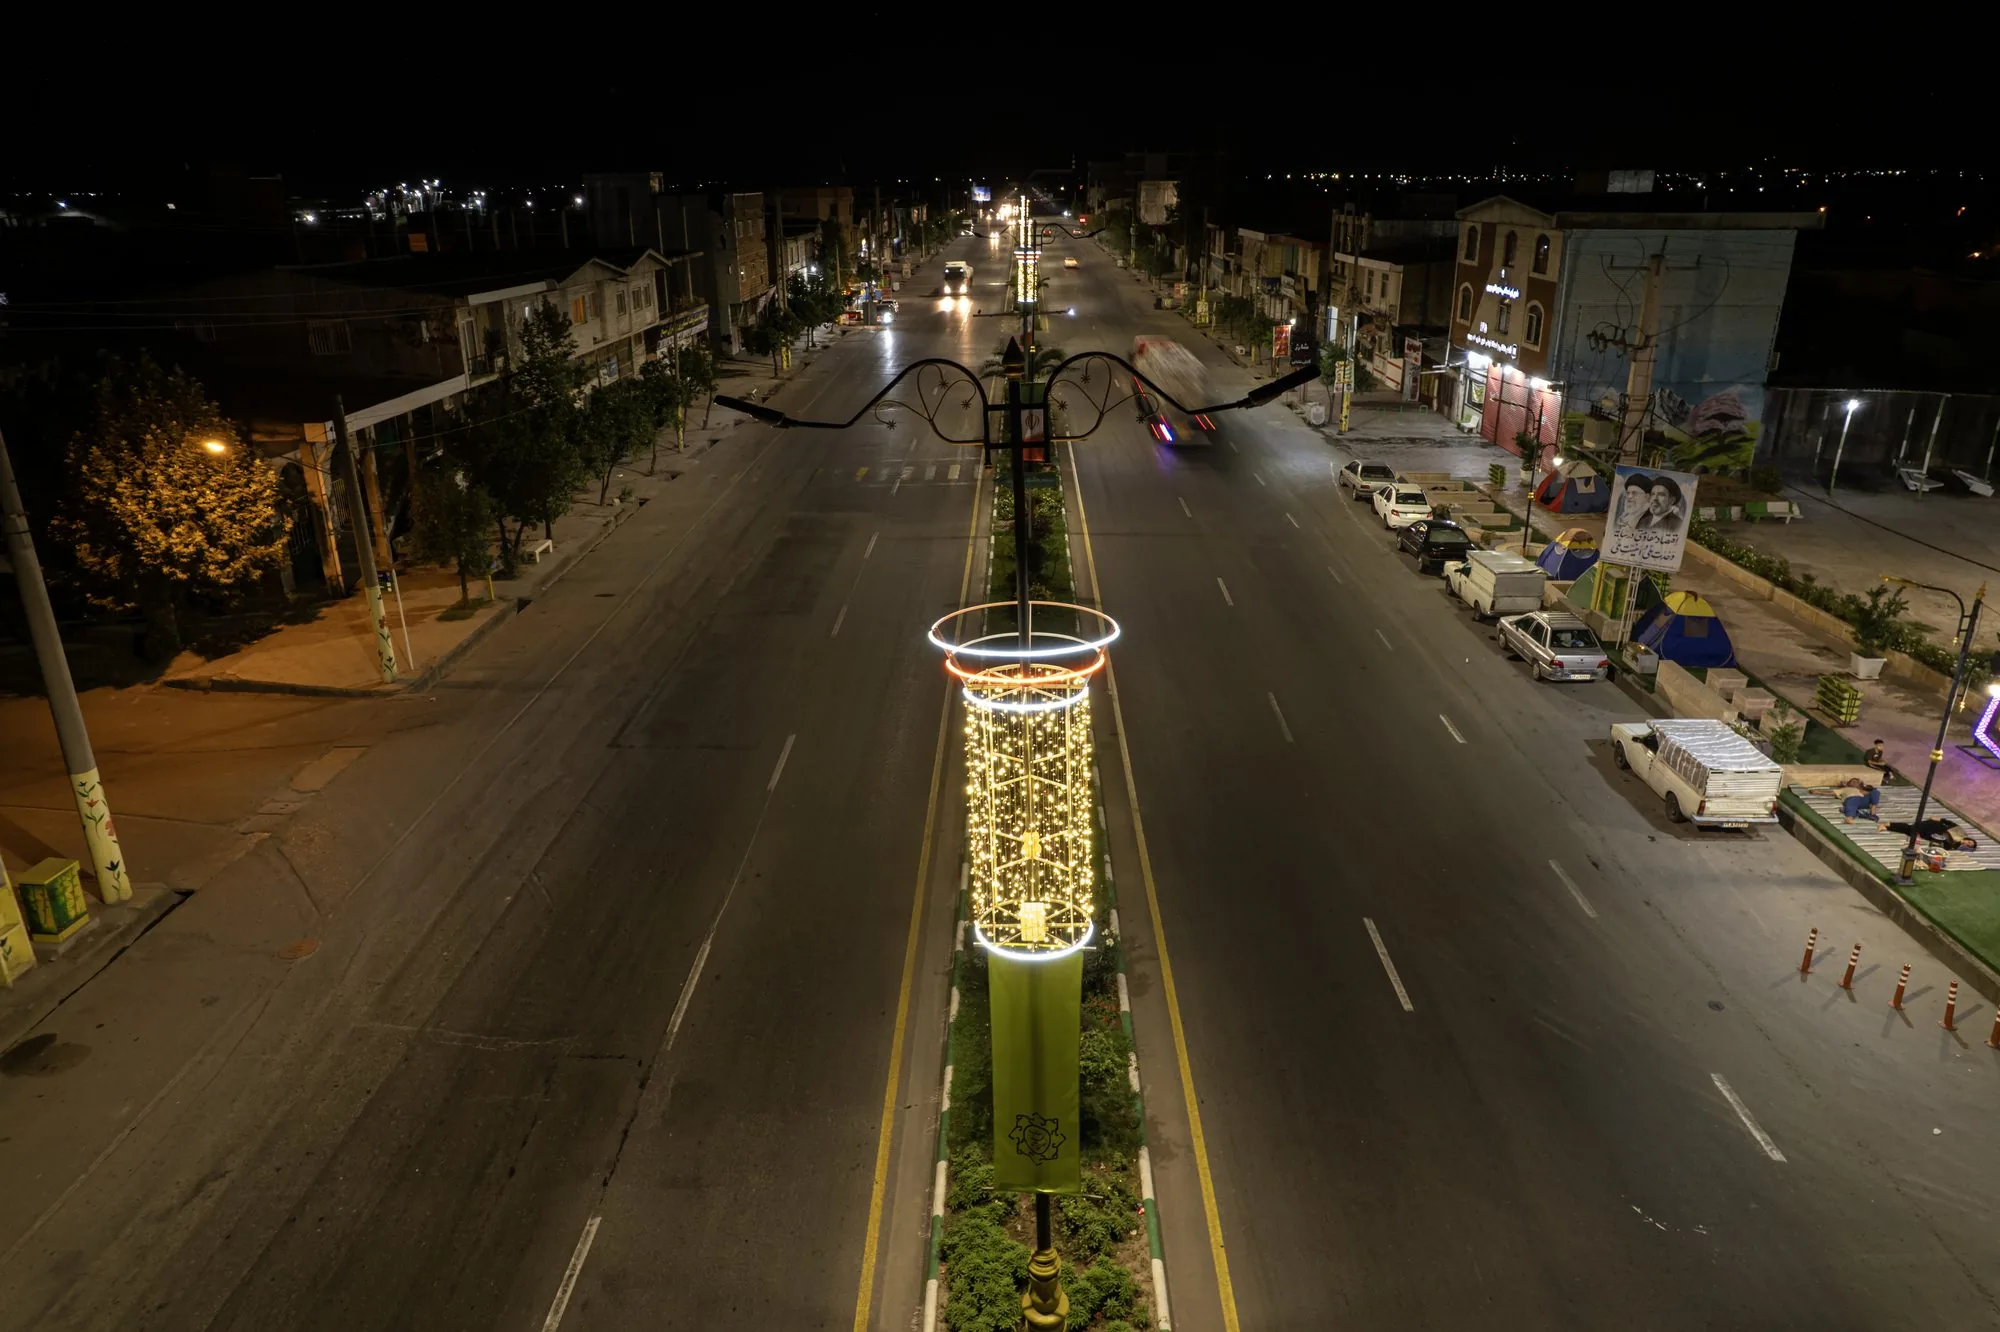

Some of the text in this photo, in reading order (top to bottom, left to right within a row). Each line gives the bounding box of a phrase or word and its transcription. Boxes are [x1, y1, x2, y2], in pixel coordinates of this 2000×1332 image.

[1655, 534, 1679, 544] اقتصاد
[1610, 543, 1621, 554] ملی
[1620, 543, 1641, 556] امنیت
[1642, 547, 1653, 559] ملی
[1651, 551, 1675, 560] وحدت
